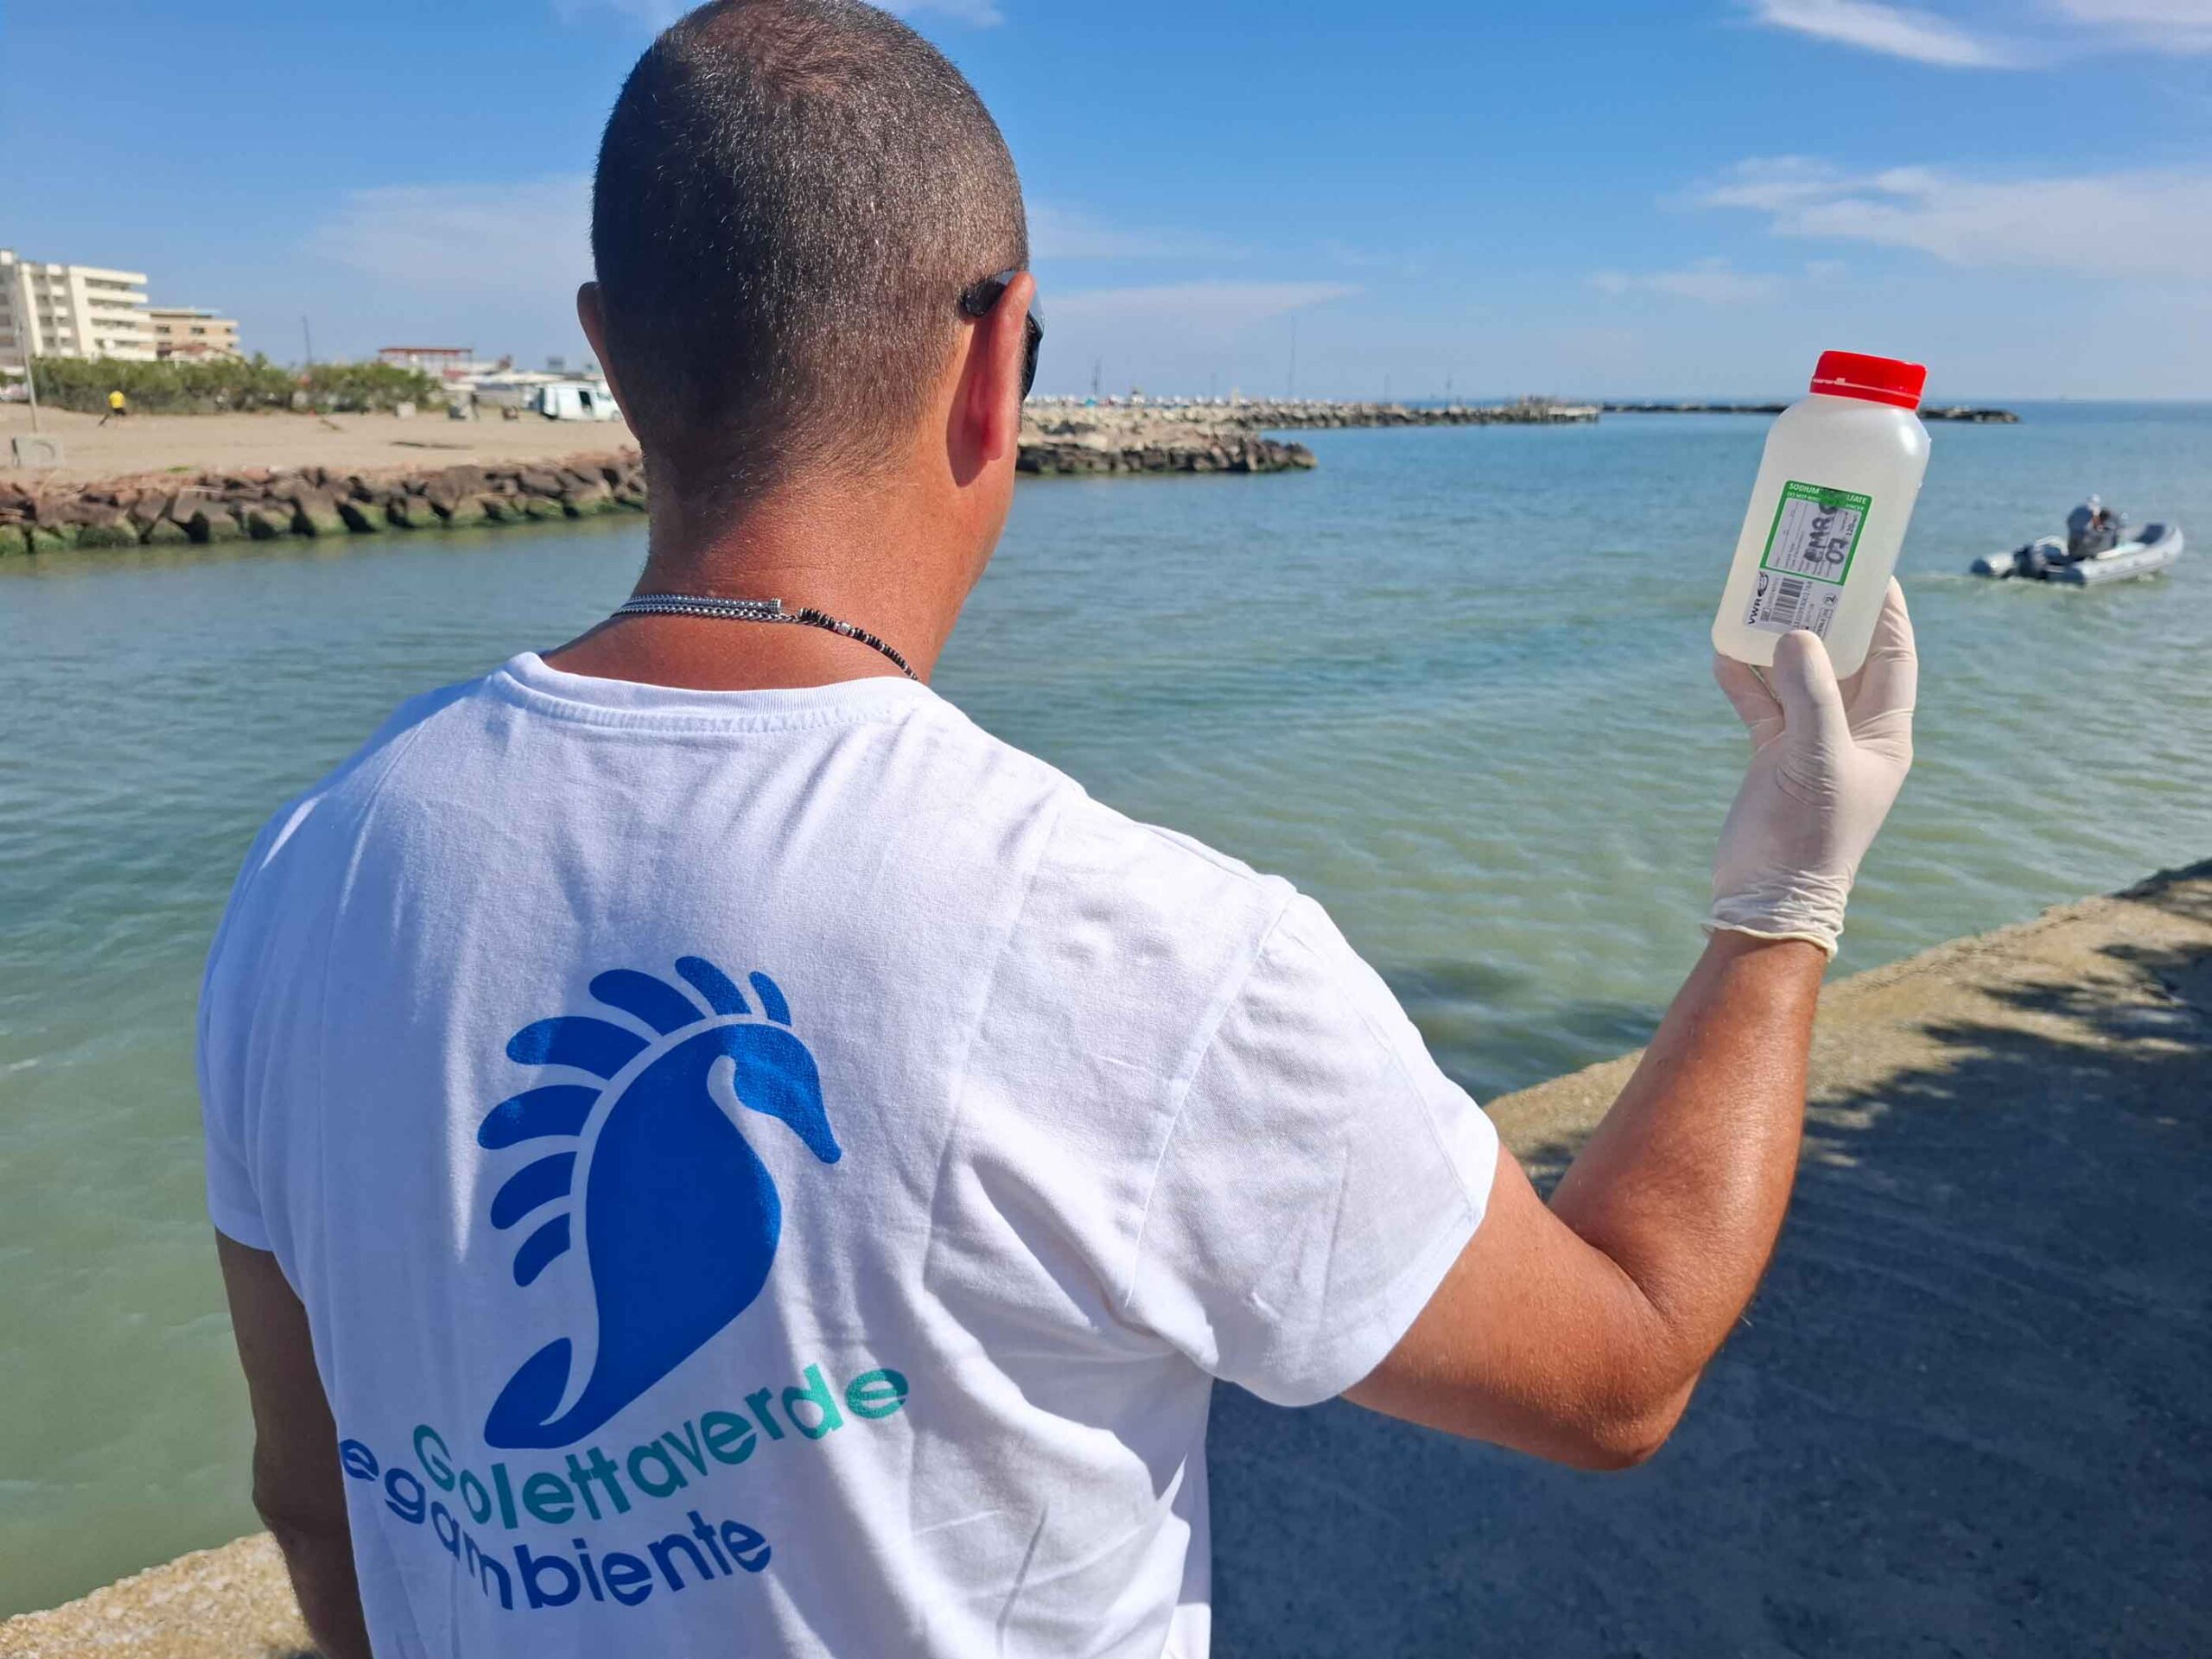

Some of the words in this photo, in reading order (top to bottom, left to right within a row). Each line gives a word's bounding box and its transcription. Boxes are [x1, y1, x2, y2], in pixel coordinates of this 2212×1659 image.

[1789, 482, 1820, 494] SODIUM
[1748, 598, 1762, 624] VWR
[340, 1439, 771, 1610] egambiente
